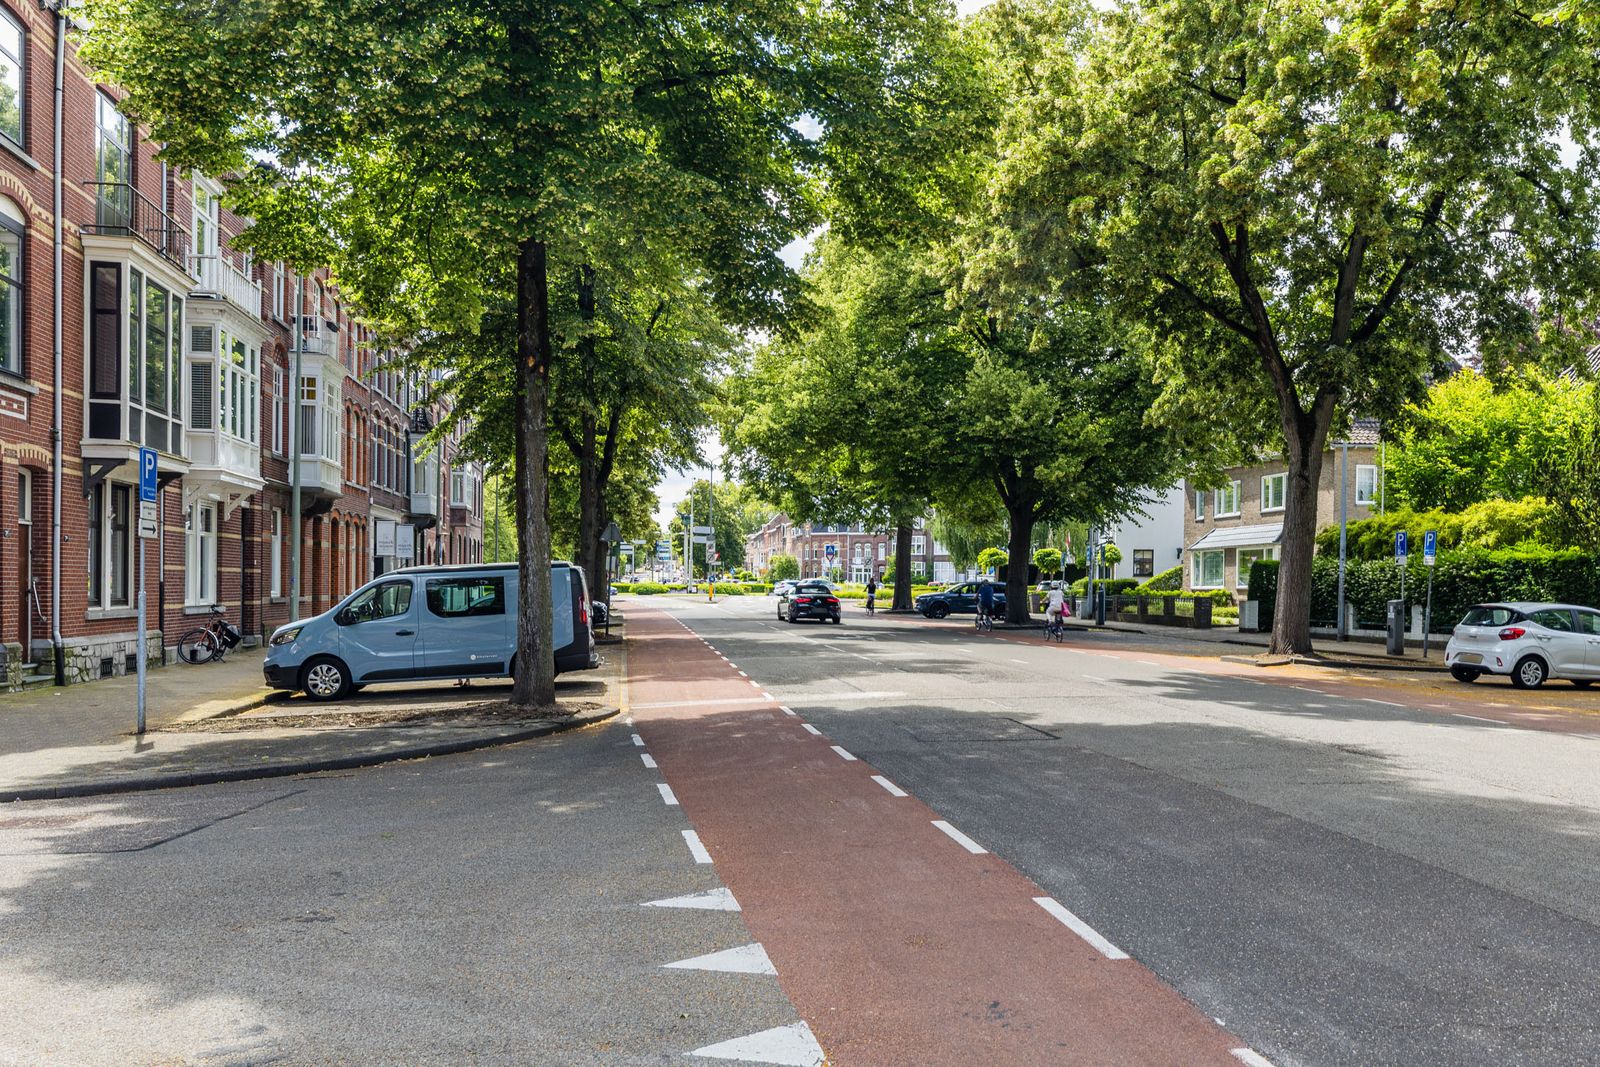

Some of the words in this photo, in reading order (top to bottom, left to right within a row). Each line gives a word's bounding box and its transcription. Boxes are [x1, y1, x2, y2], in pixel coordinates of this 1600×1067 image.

[146, 453, 154, 479] P
[1398, 534, 1404, 546] P
[1426, 534, 1434, 546] P
